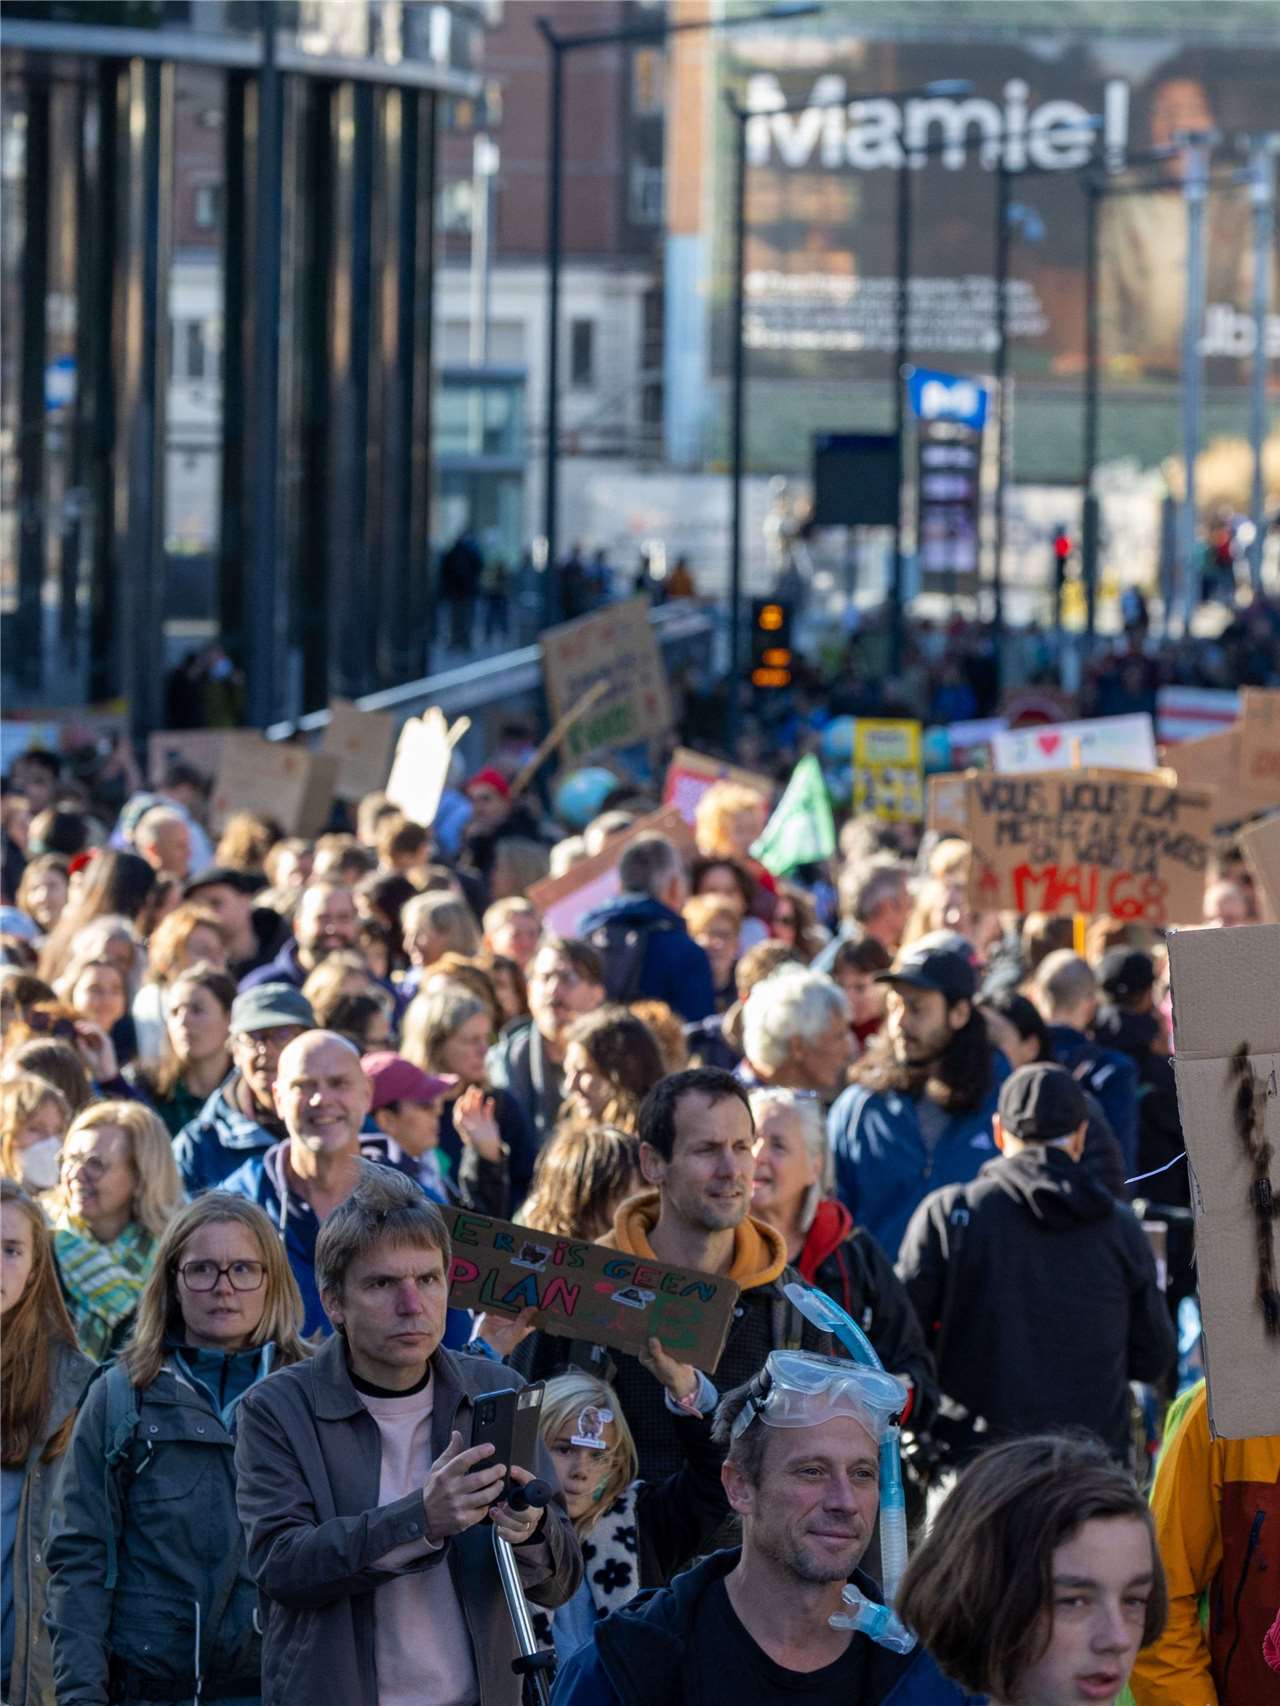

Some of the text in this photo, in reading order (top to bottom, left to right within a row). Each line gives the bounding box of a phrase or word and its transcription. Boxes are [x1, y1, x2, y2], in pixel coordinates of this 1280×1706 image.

[975, 780, 1045, 816] VOUS
[1141, 784, 1179, 823] LA
[1013, 863, 1098, 914] MAI
[1107, 870, 1169, 925] 68
[447, 1256, 582, 1318] PLAN
[452, 1213, 515, 1253] ER
[603, 1258, 718, 1302] GEEN
